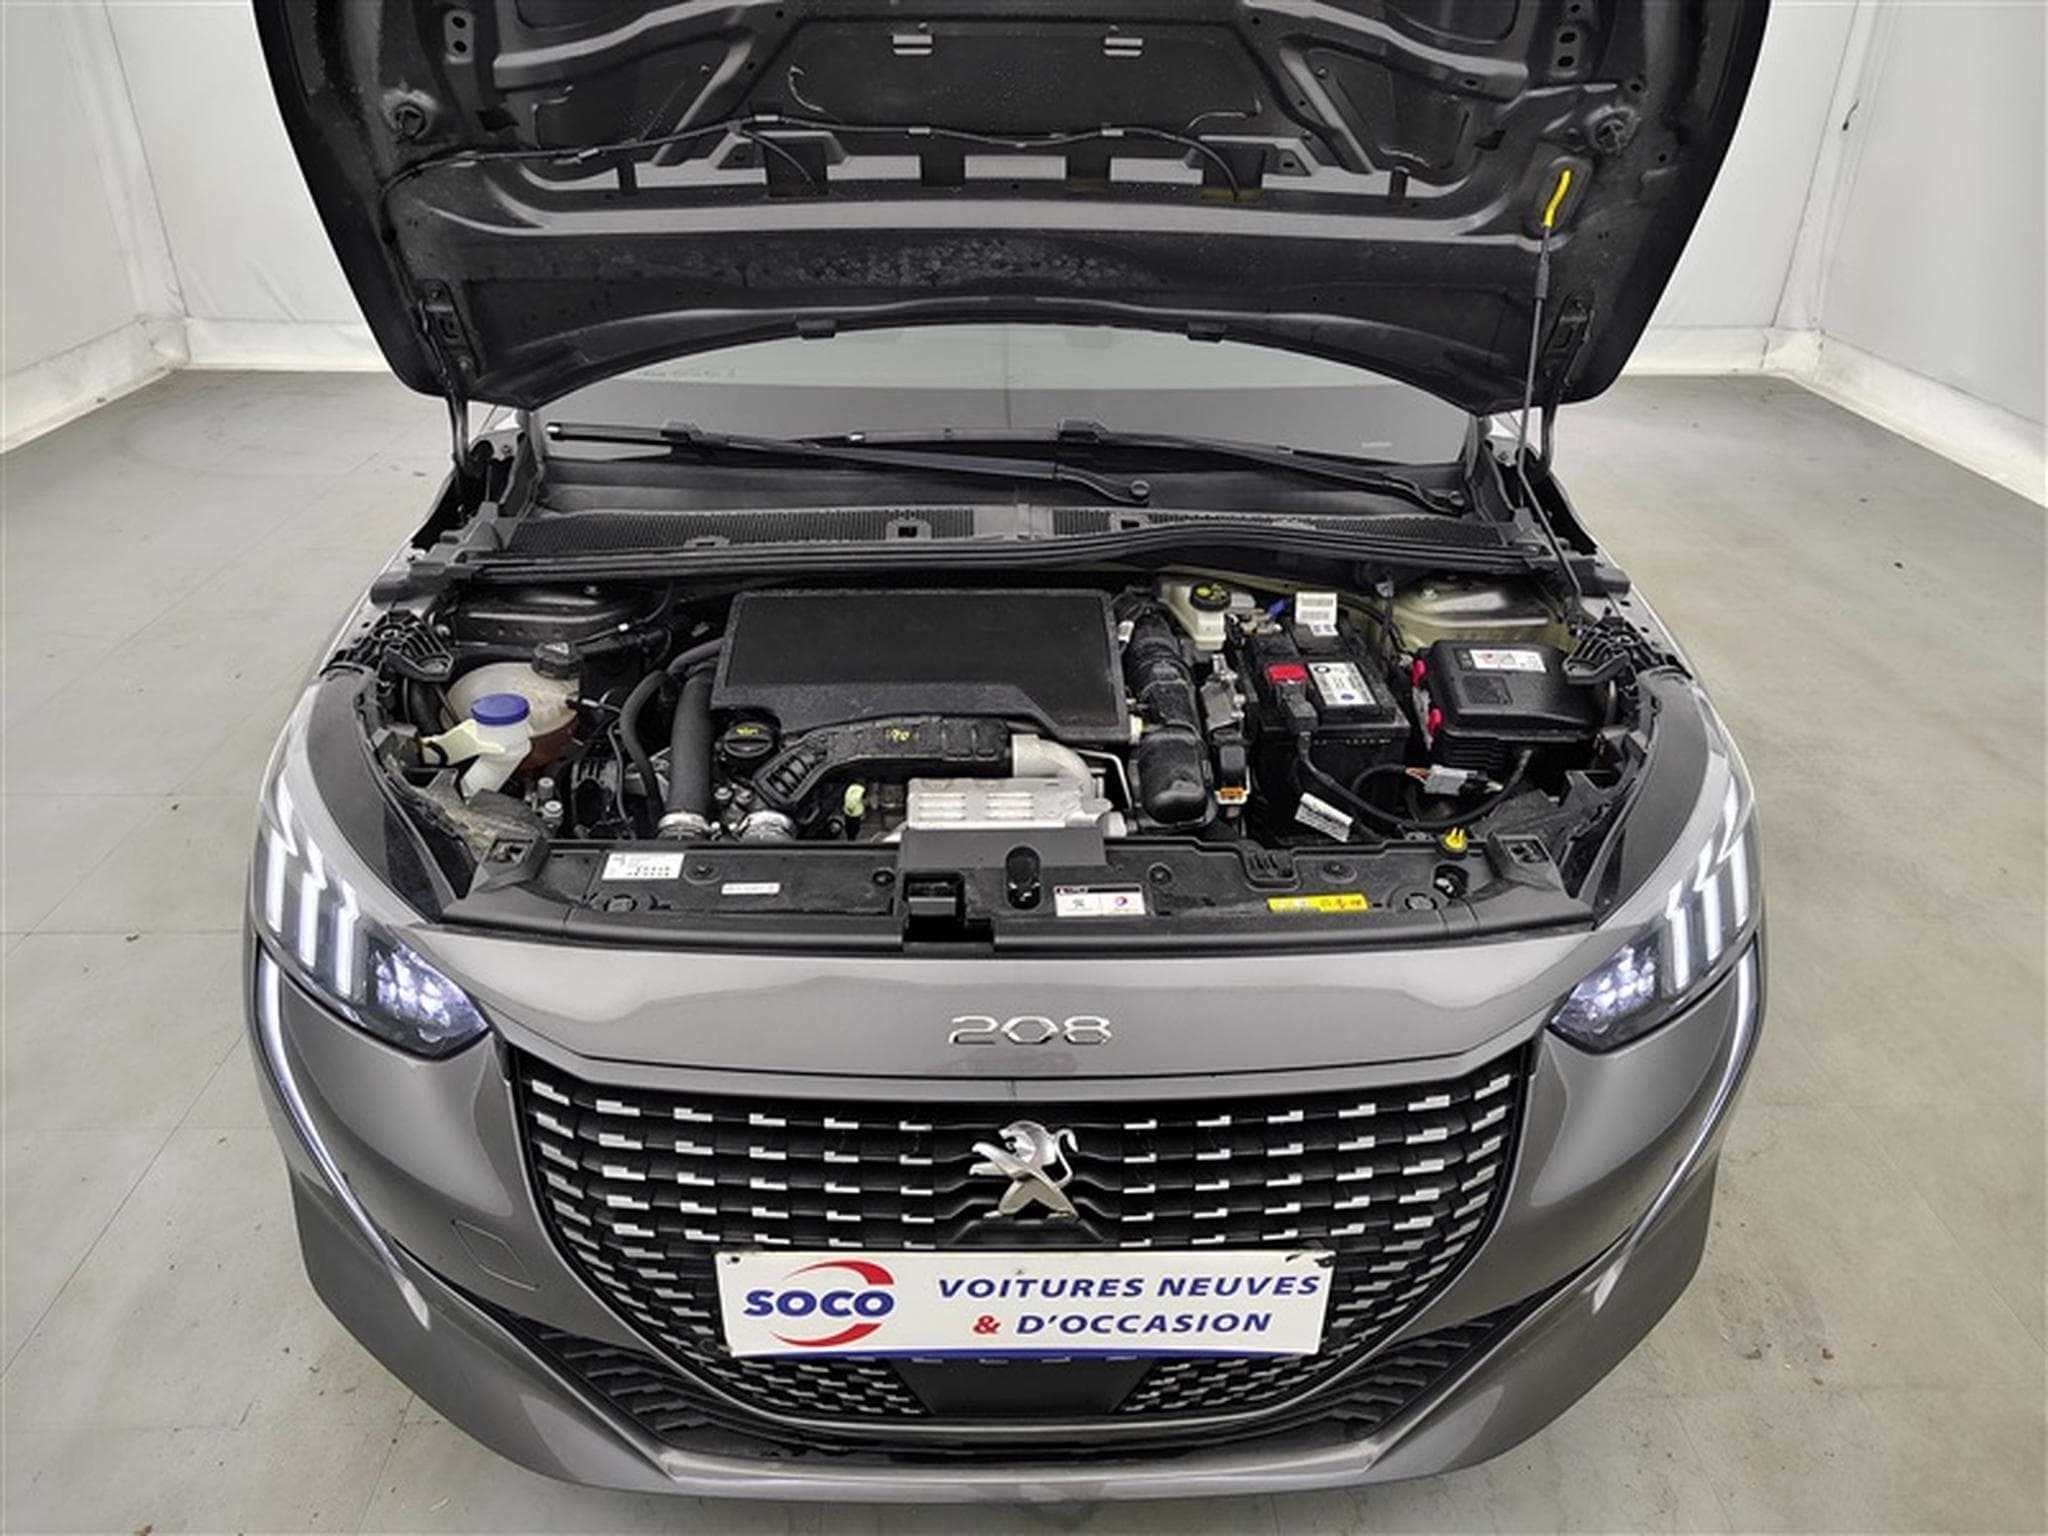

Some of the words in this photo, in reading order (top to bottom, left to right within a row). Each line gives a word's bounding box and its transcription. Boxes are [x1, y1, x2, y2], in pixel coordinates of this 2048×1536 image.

[948, 1015, 1112, 1045] 208
[938, 1278, 1144, 1298] VOITURES
[1157, 1276, 1320, 1296] NEUVES
[743, 1290, 895, 1317] SOCO
[972, 1315, 1001, 1334] &
[1016, 1313, 1272, 1334] D'OCCASION
